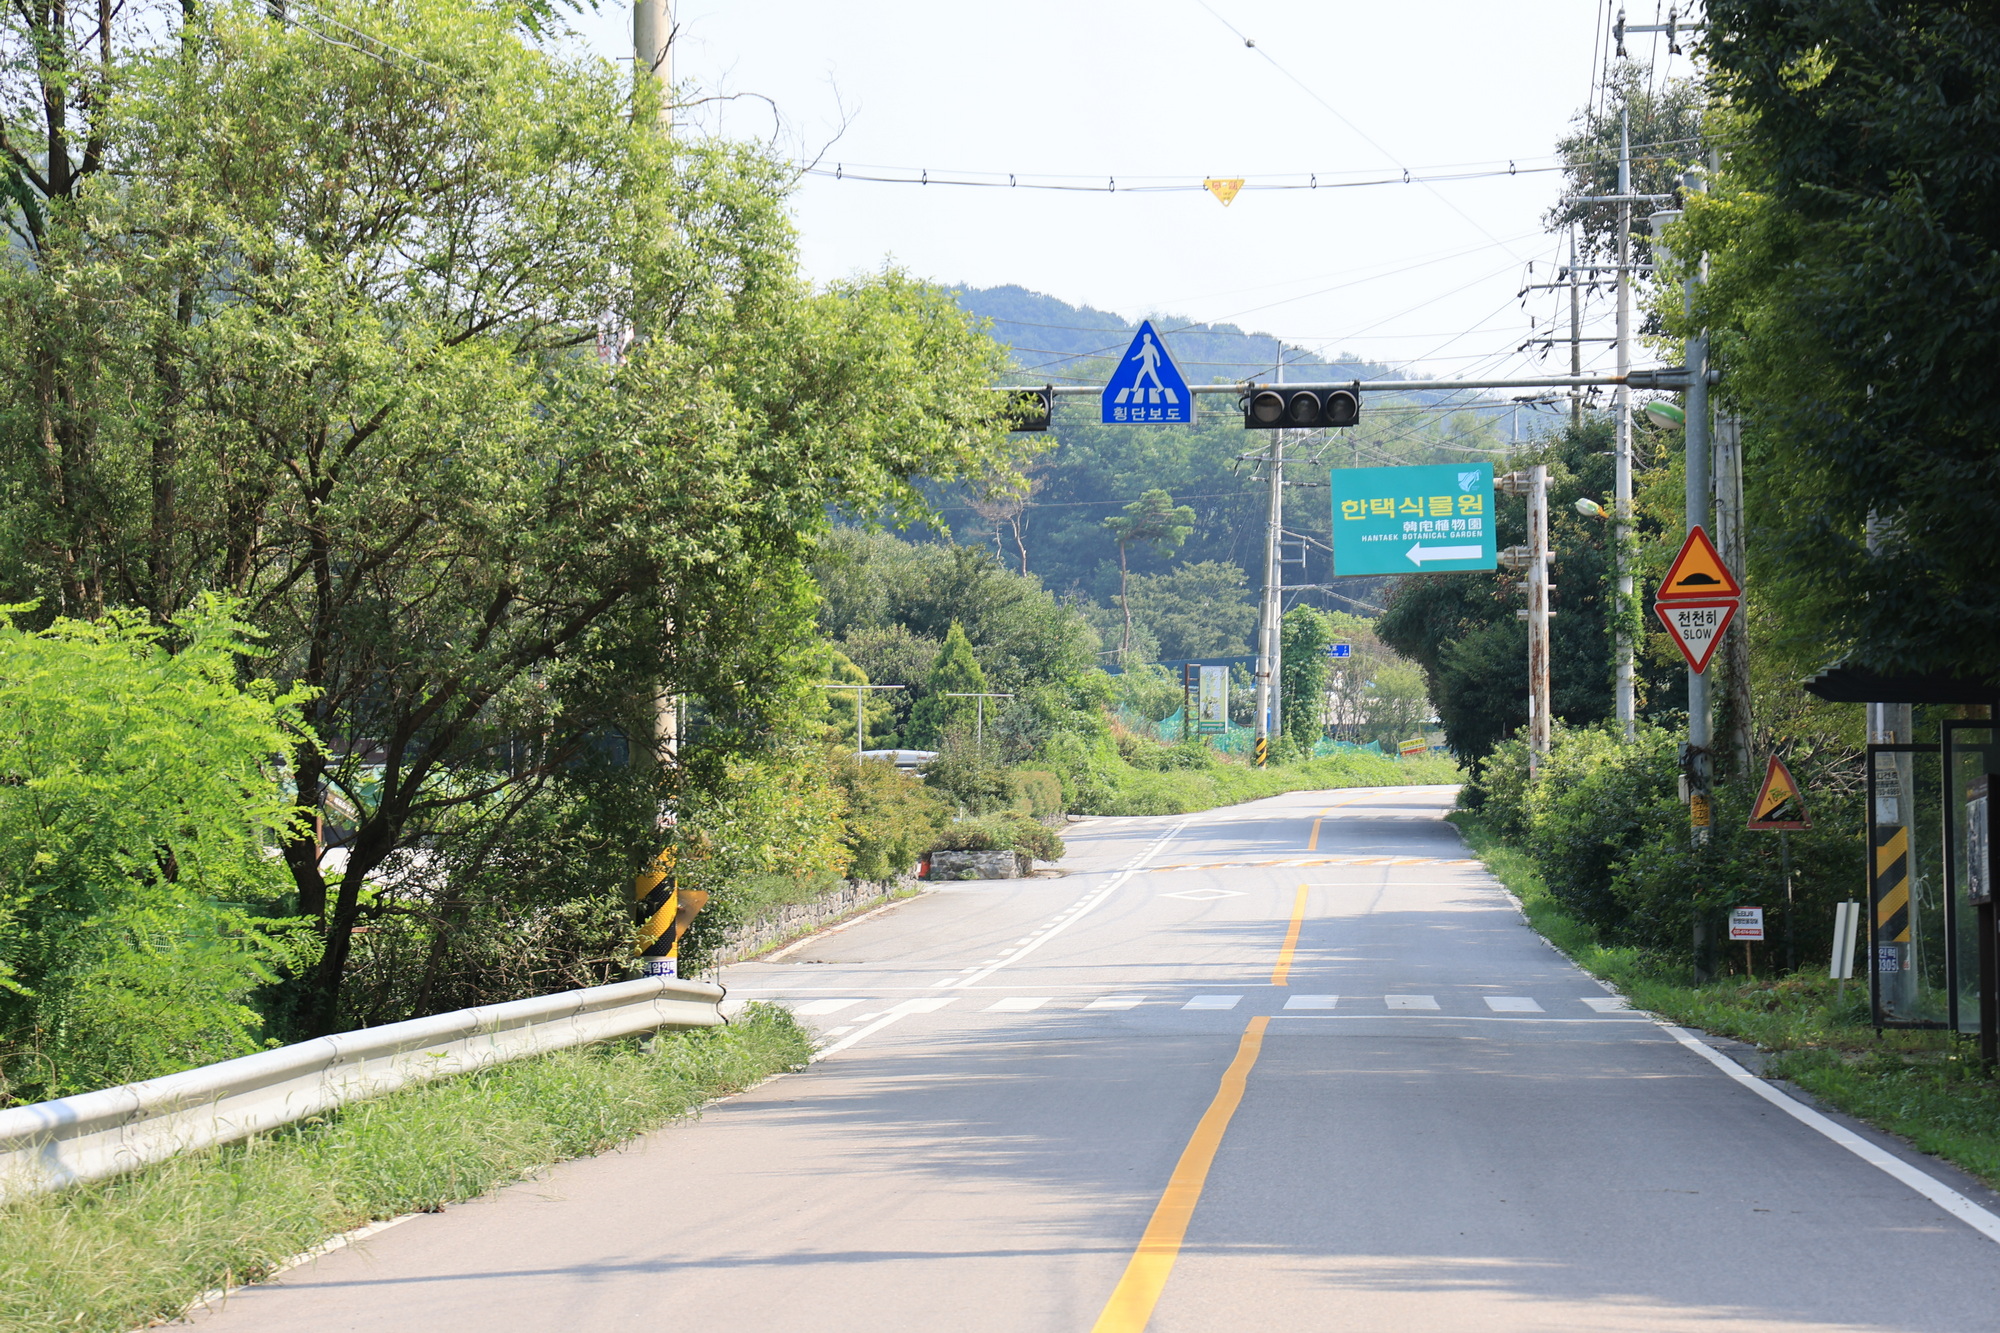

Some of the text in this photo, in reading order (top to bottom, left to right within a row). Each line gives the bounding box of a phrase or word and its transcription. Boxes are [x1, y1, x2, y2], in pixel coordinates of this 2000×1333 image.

[1113, 406, 1181, 421] 횡단보도
[1341, 494, 1483, 520] 한택식물원
[1362, 530, 1483, 542] HANTAEK BOTANICAL GARDEN
[1678, 610, 1717, 627] 천천히
[1683, 628, 1712, 640] SLOW
